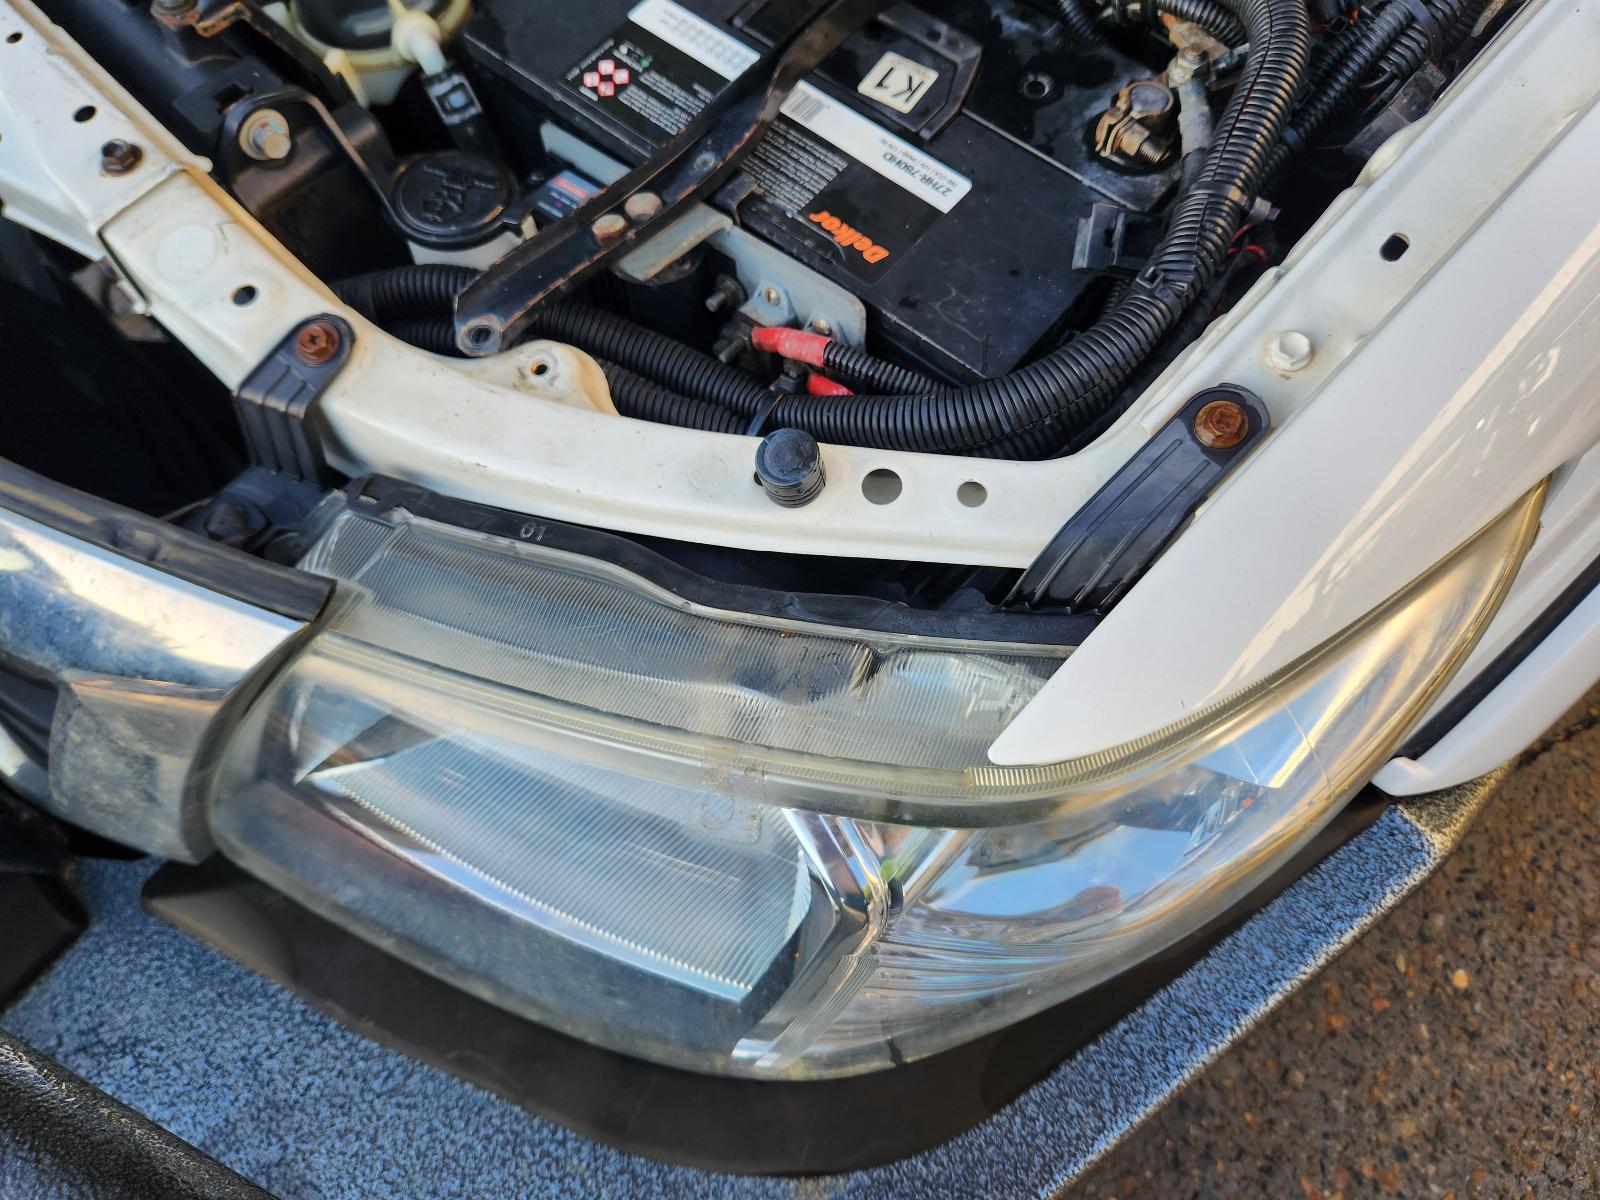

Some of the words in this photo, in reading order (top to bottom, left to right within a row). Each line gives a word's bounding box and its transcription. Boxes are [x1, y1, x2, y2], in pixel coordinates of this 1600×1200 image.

[874, 65, 924, 103] K1
[882, 151, 953, 197] 27HR-780HD
[808, 210, 890, 264] Delkor
